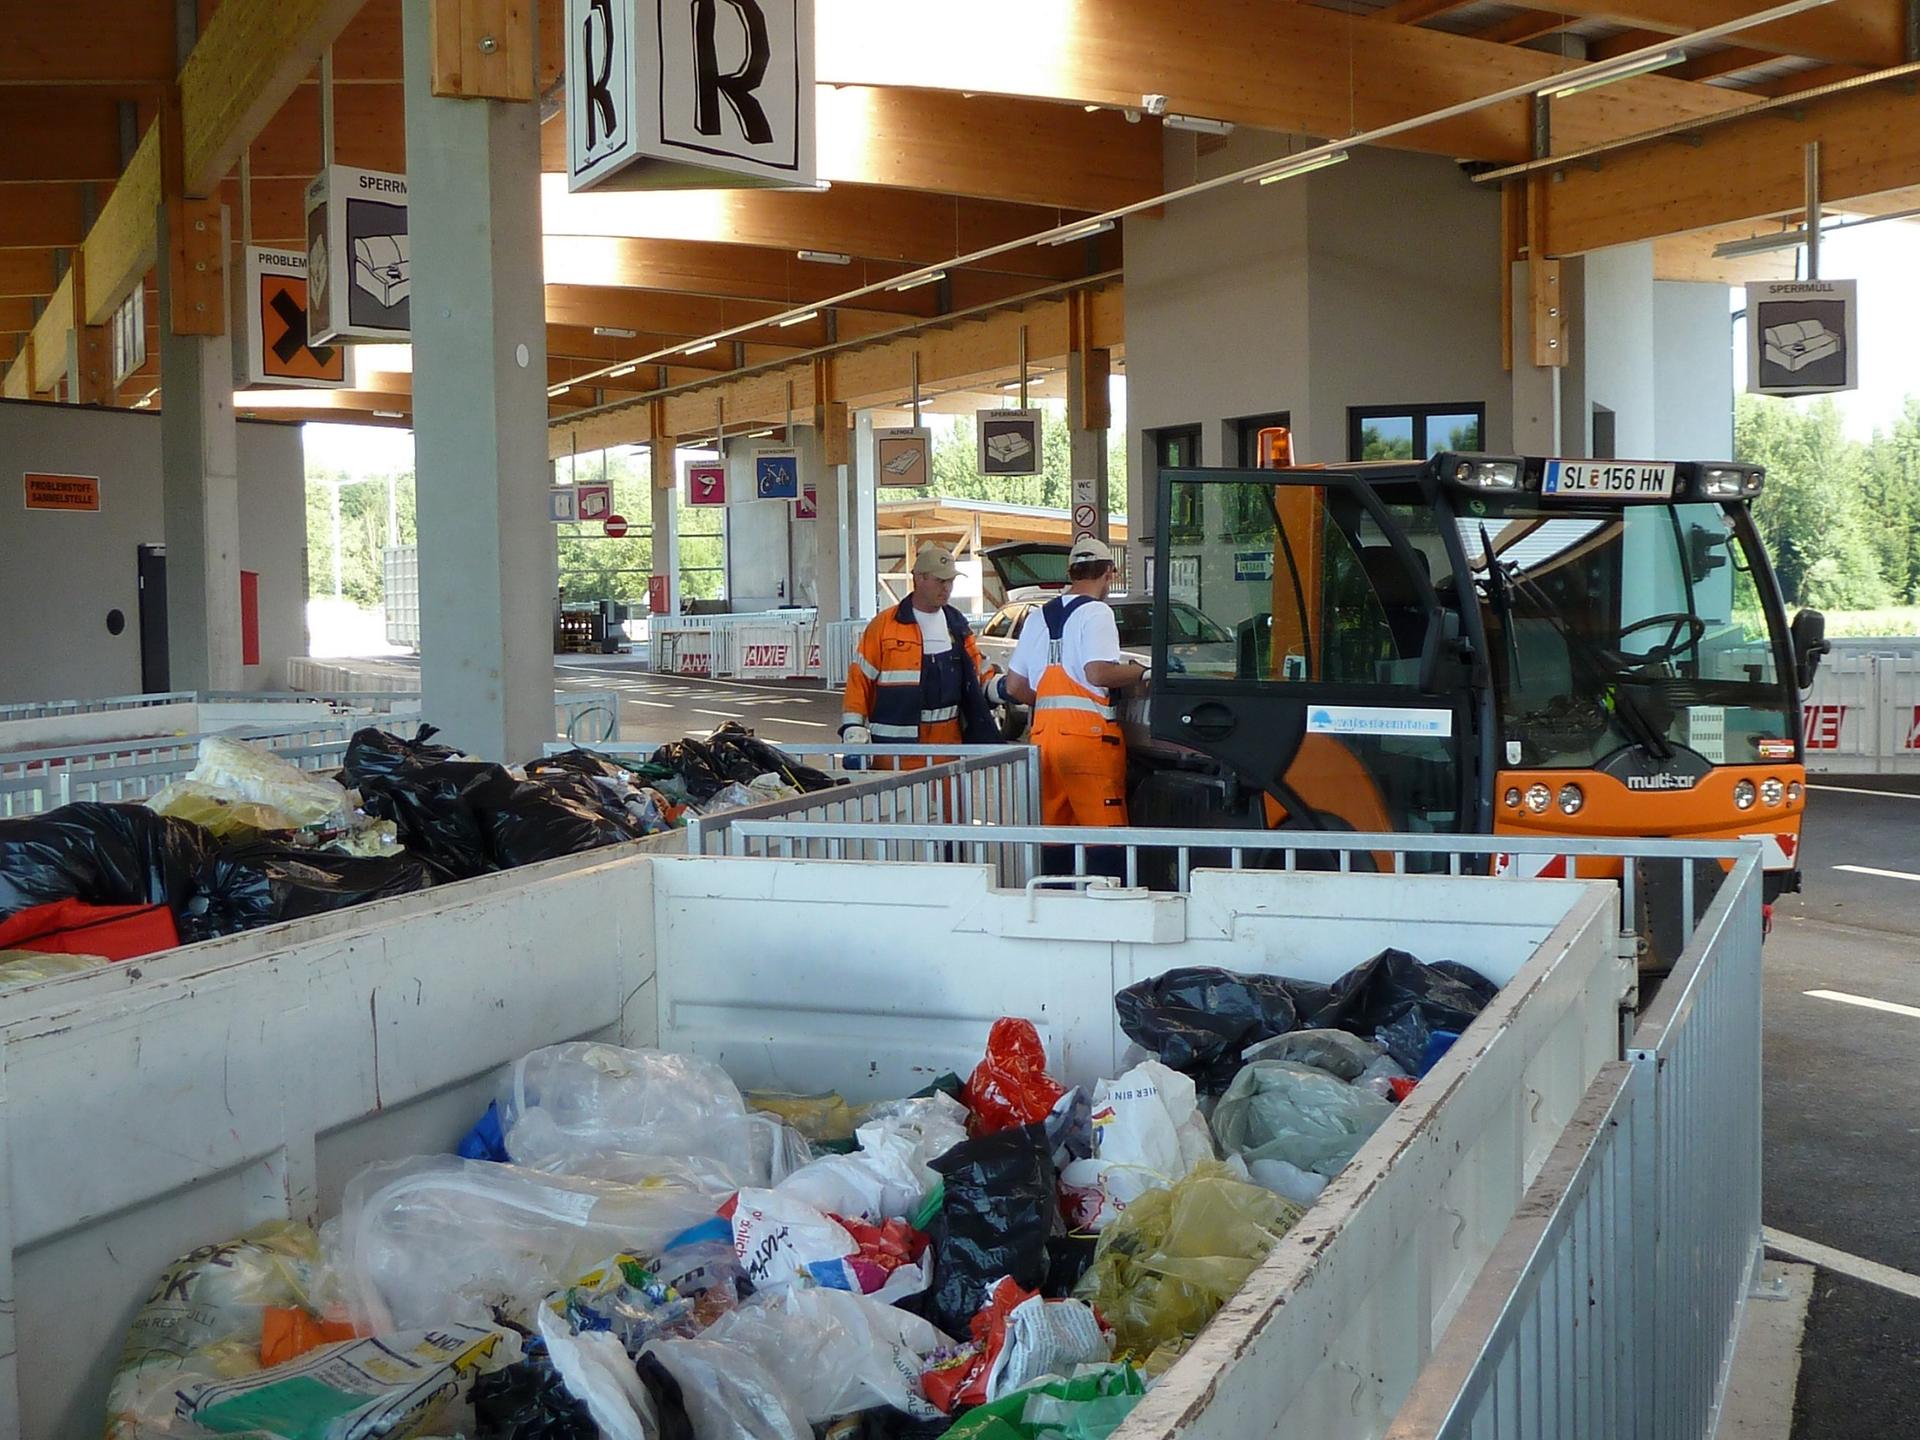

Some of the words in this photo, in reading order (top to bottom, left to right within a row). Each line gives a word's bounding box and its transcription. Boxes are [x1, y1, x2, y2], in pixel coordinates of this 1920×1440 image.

[691, 0, 774, 144] R
[359, 176, 408, 194] SPERRM
[258, 253, 307, 268] PROBLEM
[1564, 466, 1585, 489] SL
[1603, 467, 1635, 491] 156
[1640, 469, 1665, 491] HN
[1115, 1090, 1133, 1100] BIN
